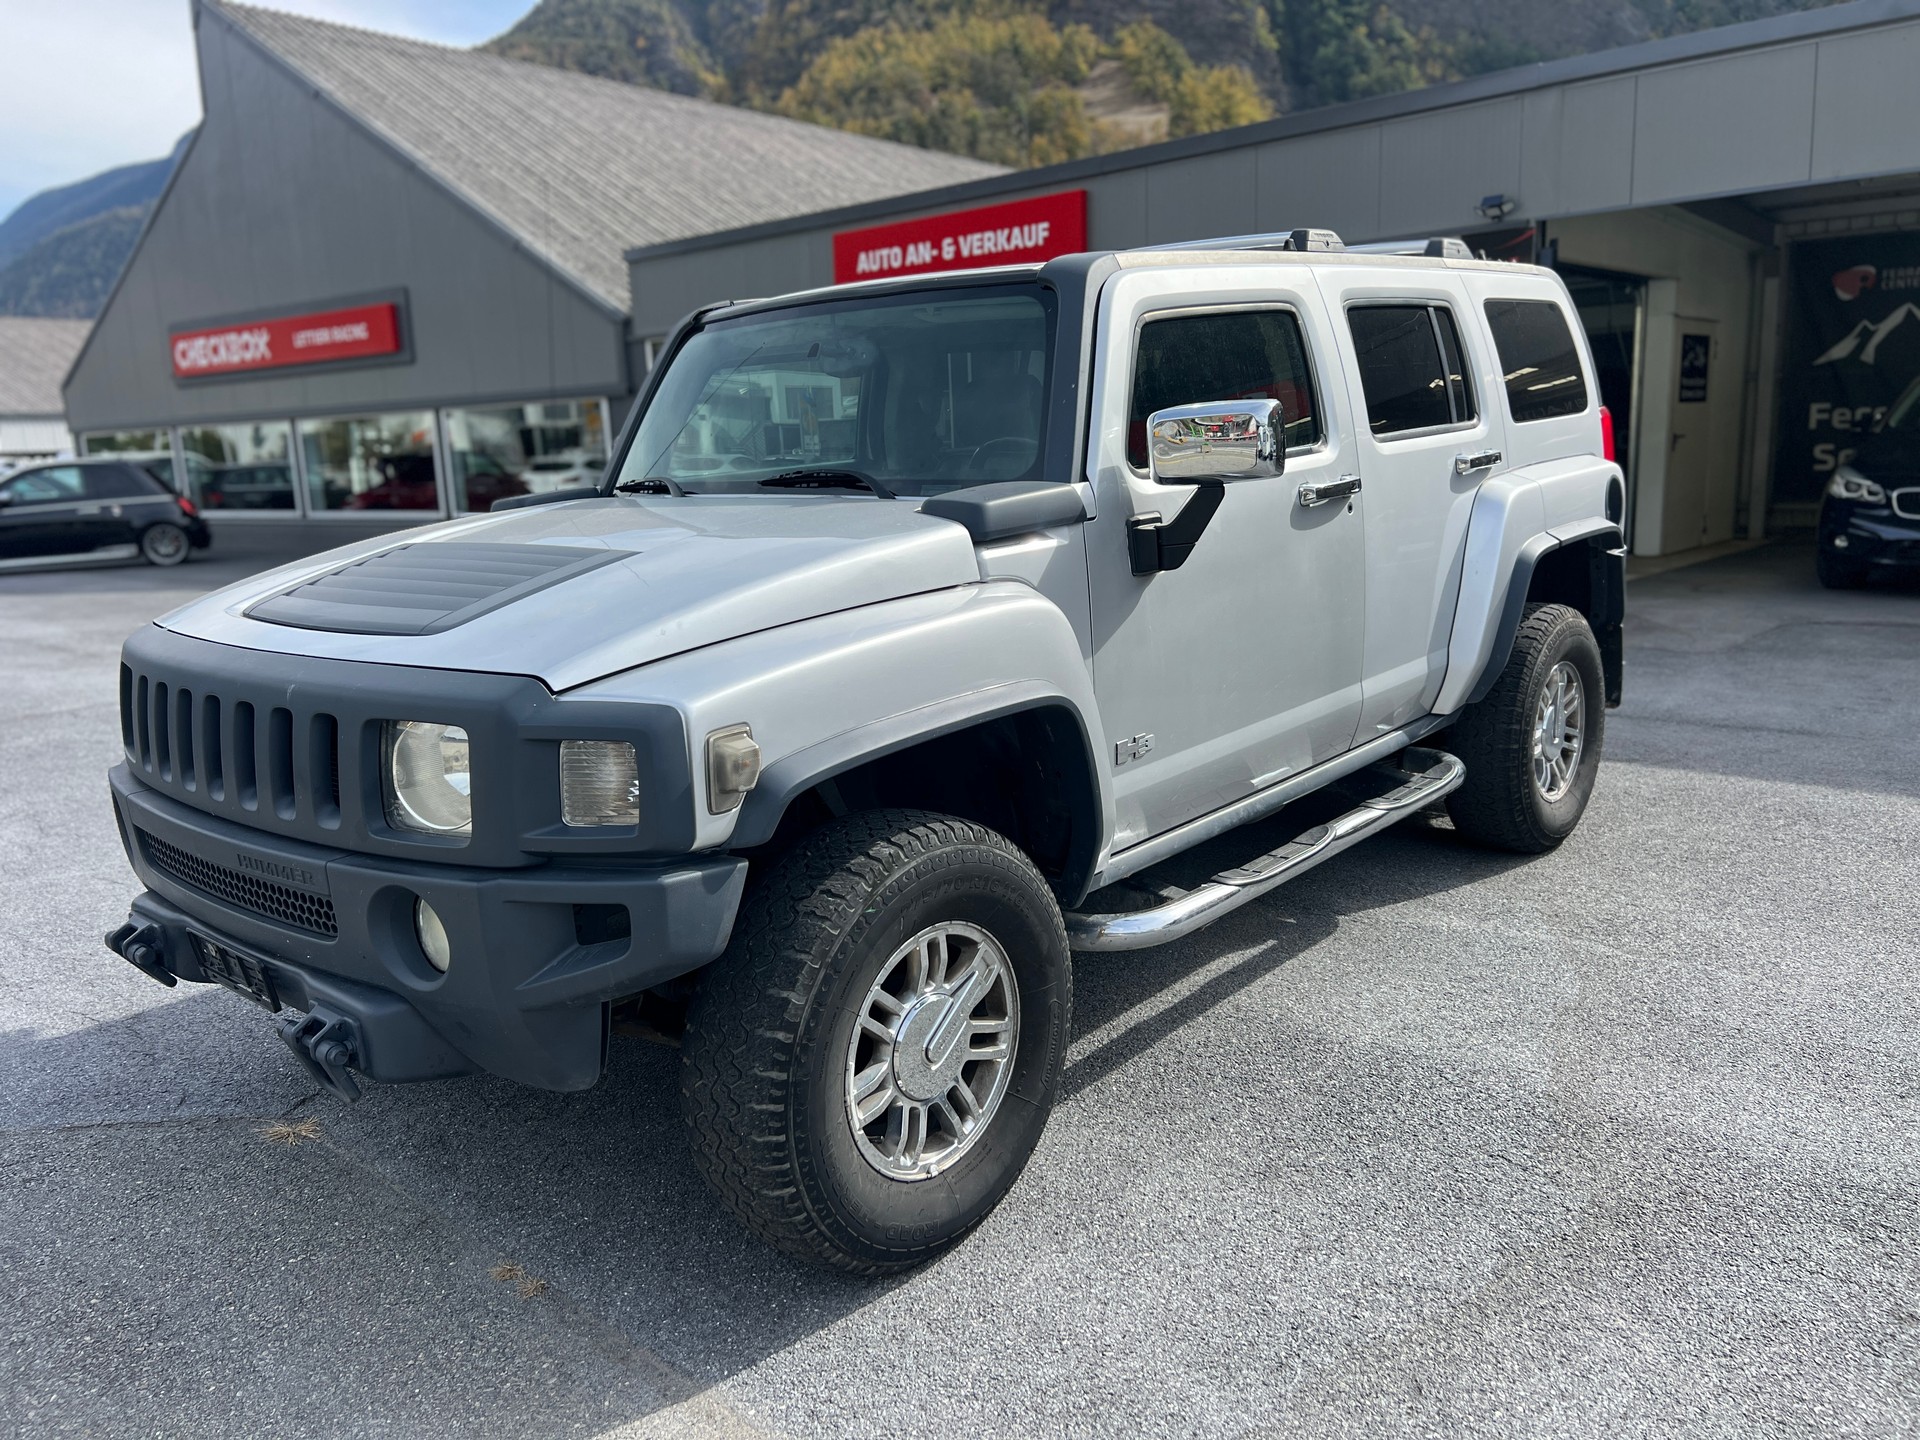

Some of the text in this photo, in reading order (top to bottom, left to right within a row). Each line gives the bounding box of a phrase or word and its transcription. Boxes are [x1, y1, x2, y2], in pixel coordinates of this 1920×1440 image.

[856, 221, 1051, 275] AUTO AN- & VERKAUF
[174, 326, 272, 370] CHECKBOX
[1115, 732, 1155, 767] H3
[237, 853, 314, 885] HUMMER
